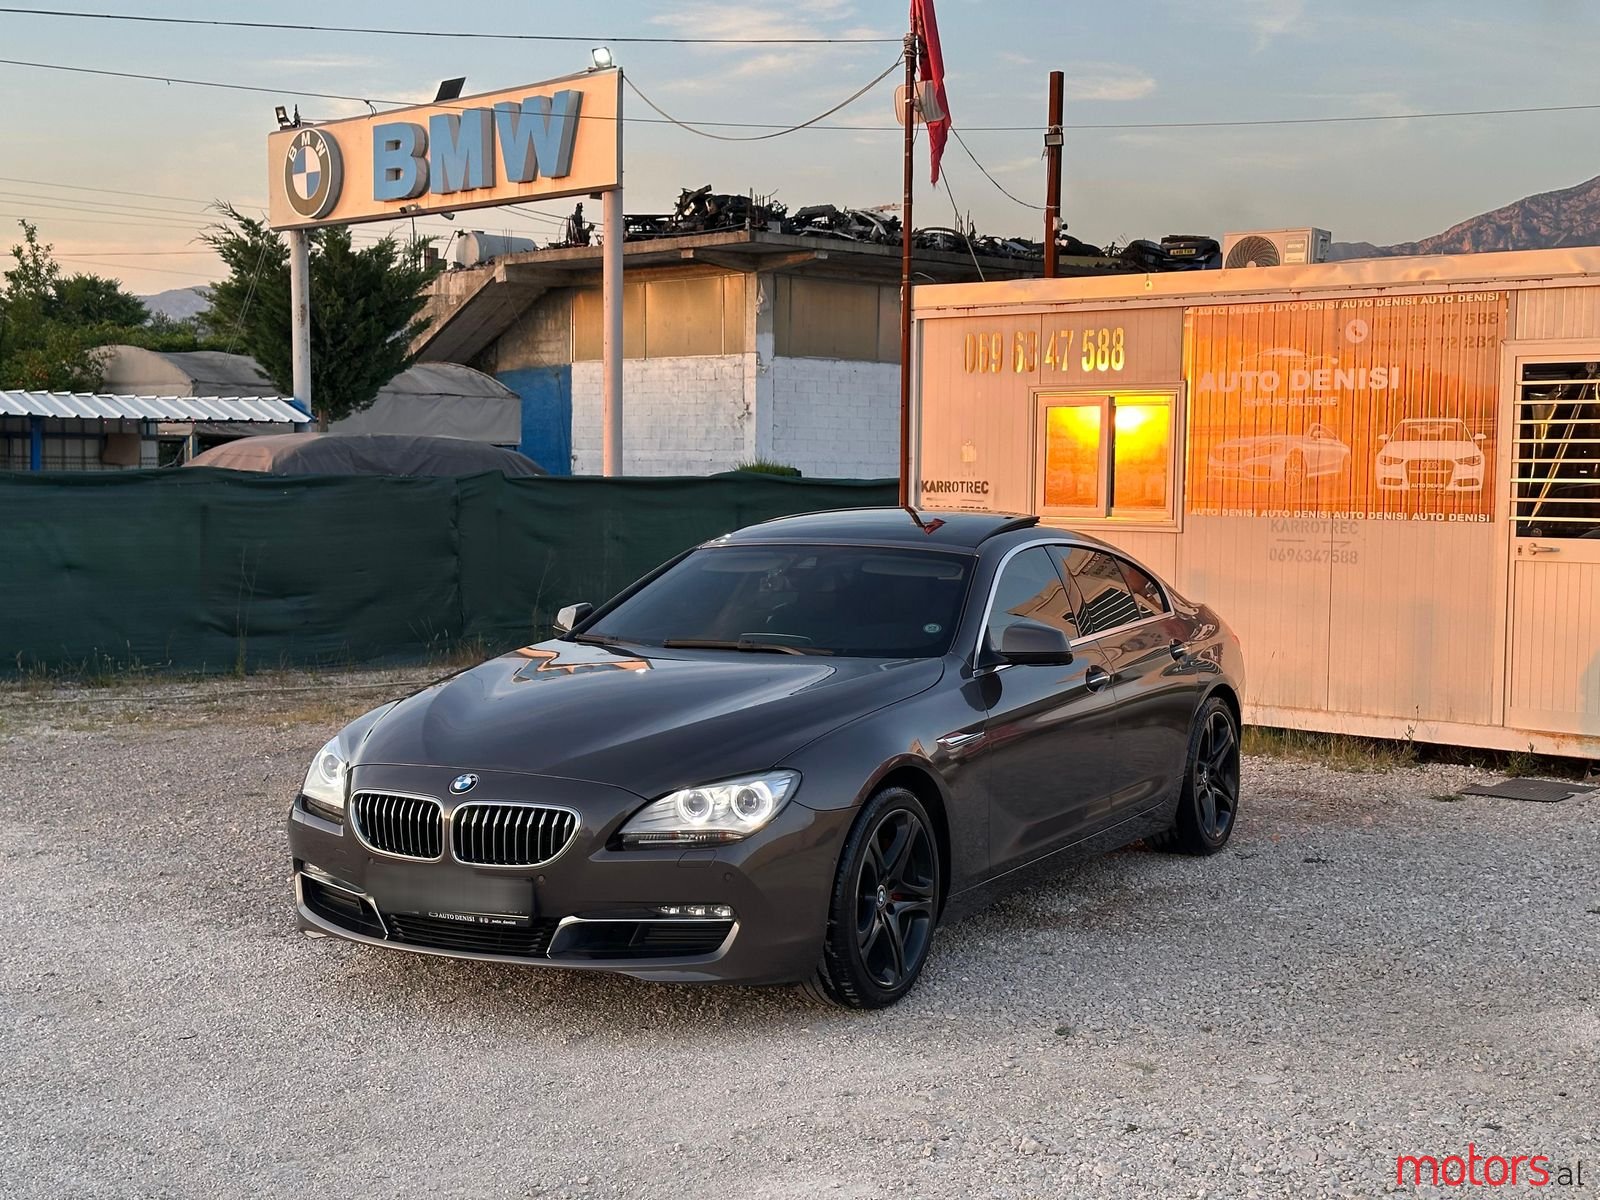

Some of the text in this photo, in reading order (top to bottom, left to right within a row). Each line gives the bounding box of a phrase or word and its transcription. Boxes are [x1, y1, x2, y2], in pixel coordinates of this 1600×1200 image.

[288, 131, 326, 162] BMW
[373, 89, 584, 202] BMW
[1197, 292, 1499, 316] AUTO DENISI AUTO DENISI AUTO DENISI AUTO DENISI
[964, 327, 1125, 374] 069 63 47 588
[1199, 366, 1400, 393] AUTO DENISI
[920, 480, 989, 494] KARROTREC
[1190, 507, 1490, 523] AUTO DENISI AUTO DENISI AUTO DENISI AUTO DENISI
[1270, 519, 1359, 534] KARROTREC
[1268, 547, 1359, 564] 0696347588
[438, 912, 454, 920] AUTO
[455, 914, 475, 922] DENISI
